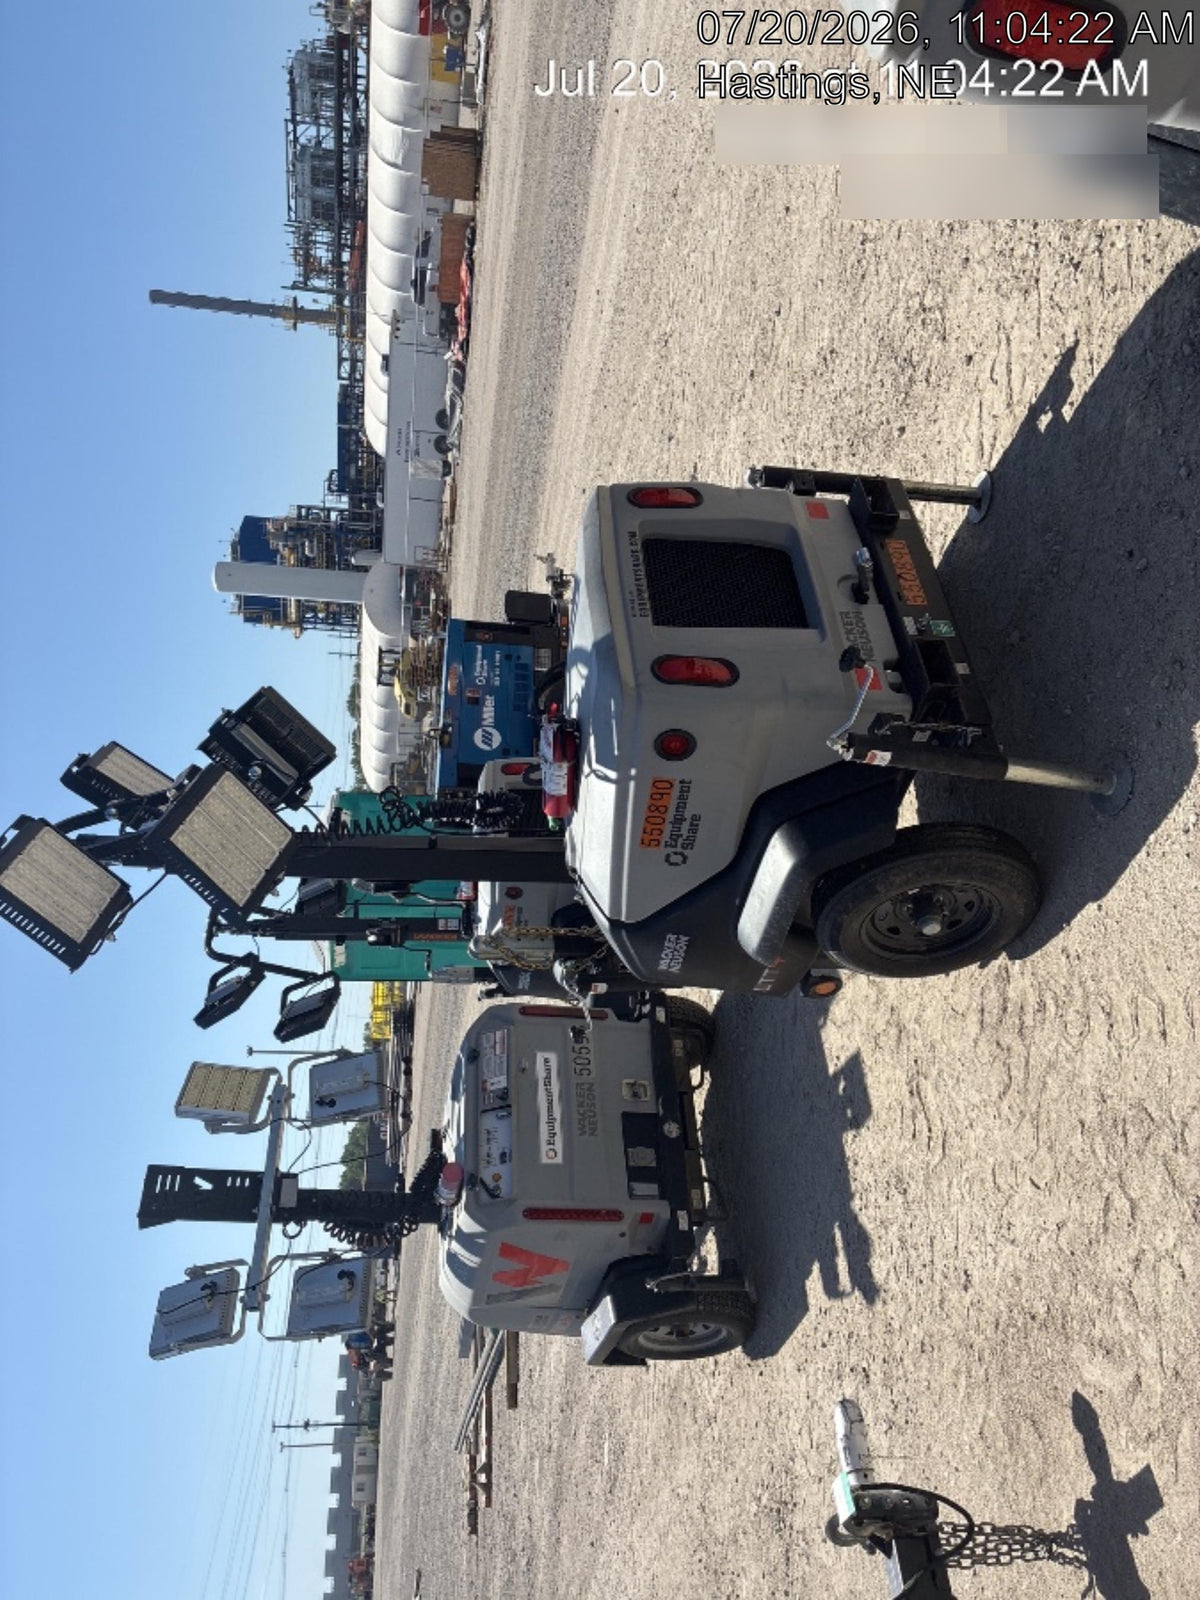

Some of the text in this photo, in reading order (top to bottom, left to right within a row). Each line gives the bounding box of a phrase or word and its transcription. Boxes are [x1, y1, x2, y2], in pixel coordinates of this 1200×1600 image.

[839, 611, 860, 650] ACKER
[640, 779, 674, 848] 550890
[663, 778, 692, 849] Equipment
[680, 813, 701, 851] Share
[658, 934, 678, 970] WACKER
[668, 934, 690, 972] NEUSON
[542, 1057, 557, 1147] EquipmentShare
[575, 1082, 588, 1137] WACKER
[586, 1082, 599, 1137] NEUSON
